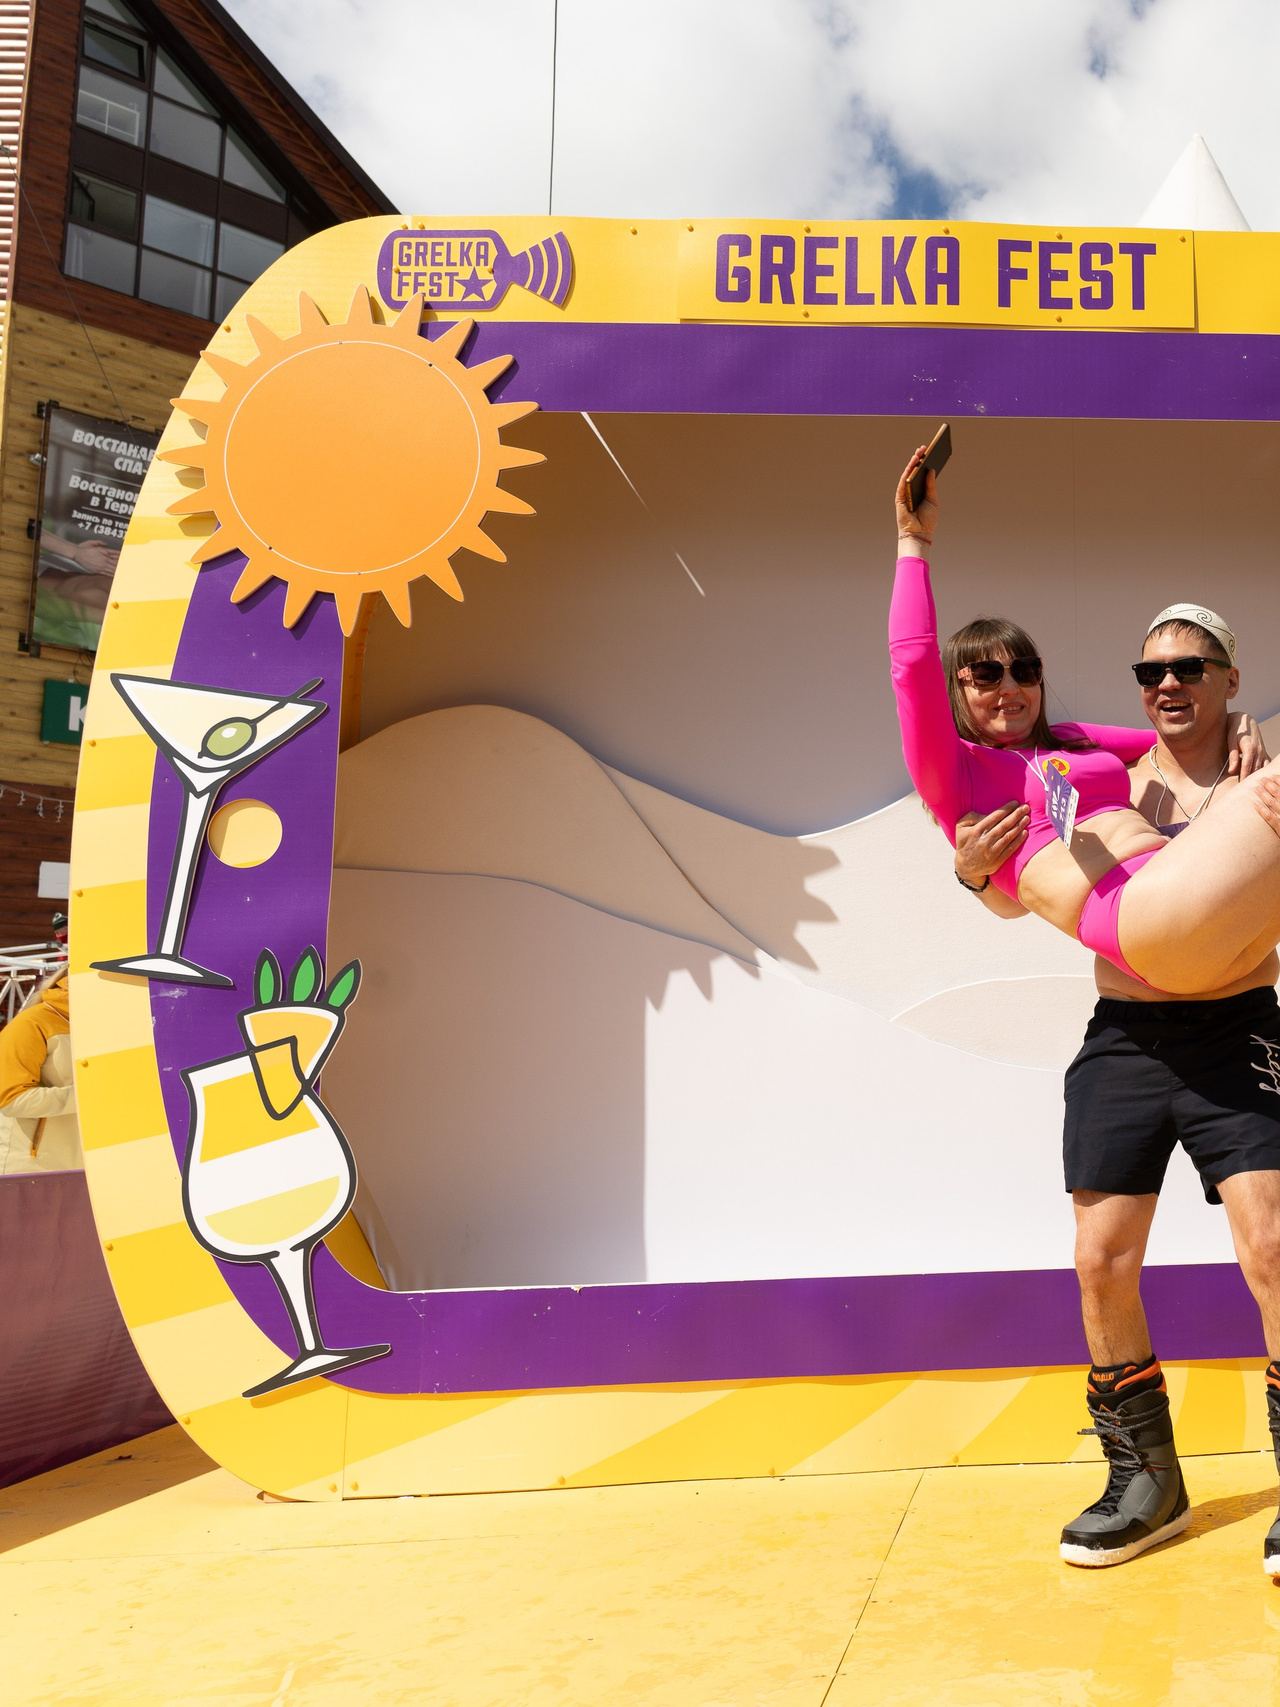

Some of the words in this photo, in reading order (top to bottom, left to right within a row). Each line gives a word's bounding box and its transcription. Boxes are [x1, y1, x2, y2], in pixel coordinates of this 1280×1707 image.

[398, 241, 490, 267] GRELKA
[397, 271, 460, 298] FEST
[715, 233, 960, 305] GRELKA
[997, 238, 1157, 310] FEST
[72, 510, 101, 523] Запись
[102, 518, 113, 526] по
[78, 522, 92, 530] +7
